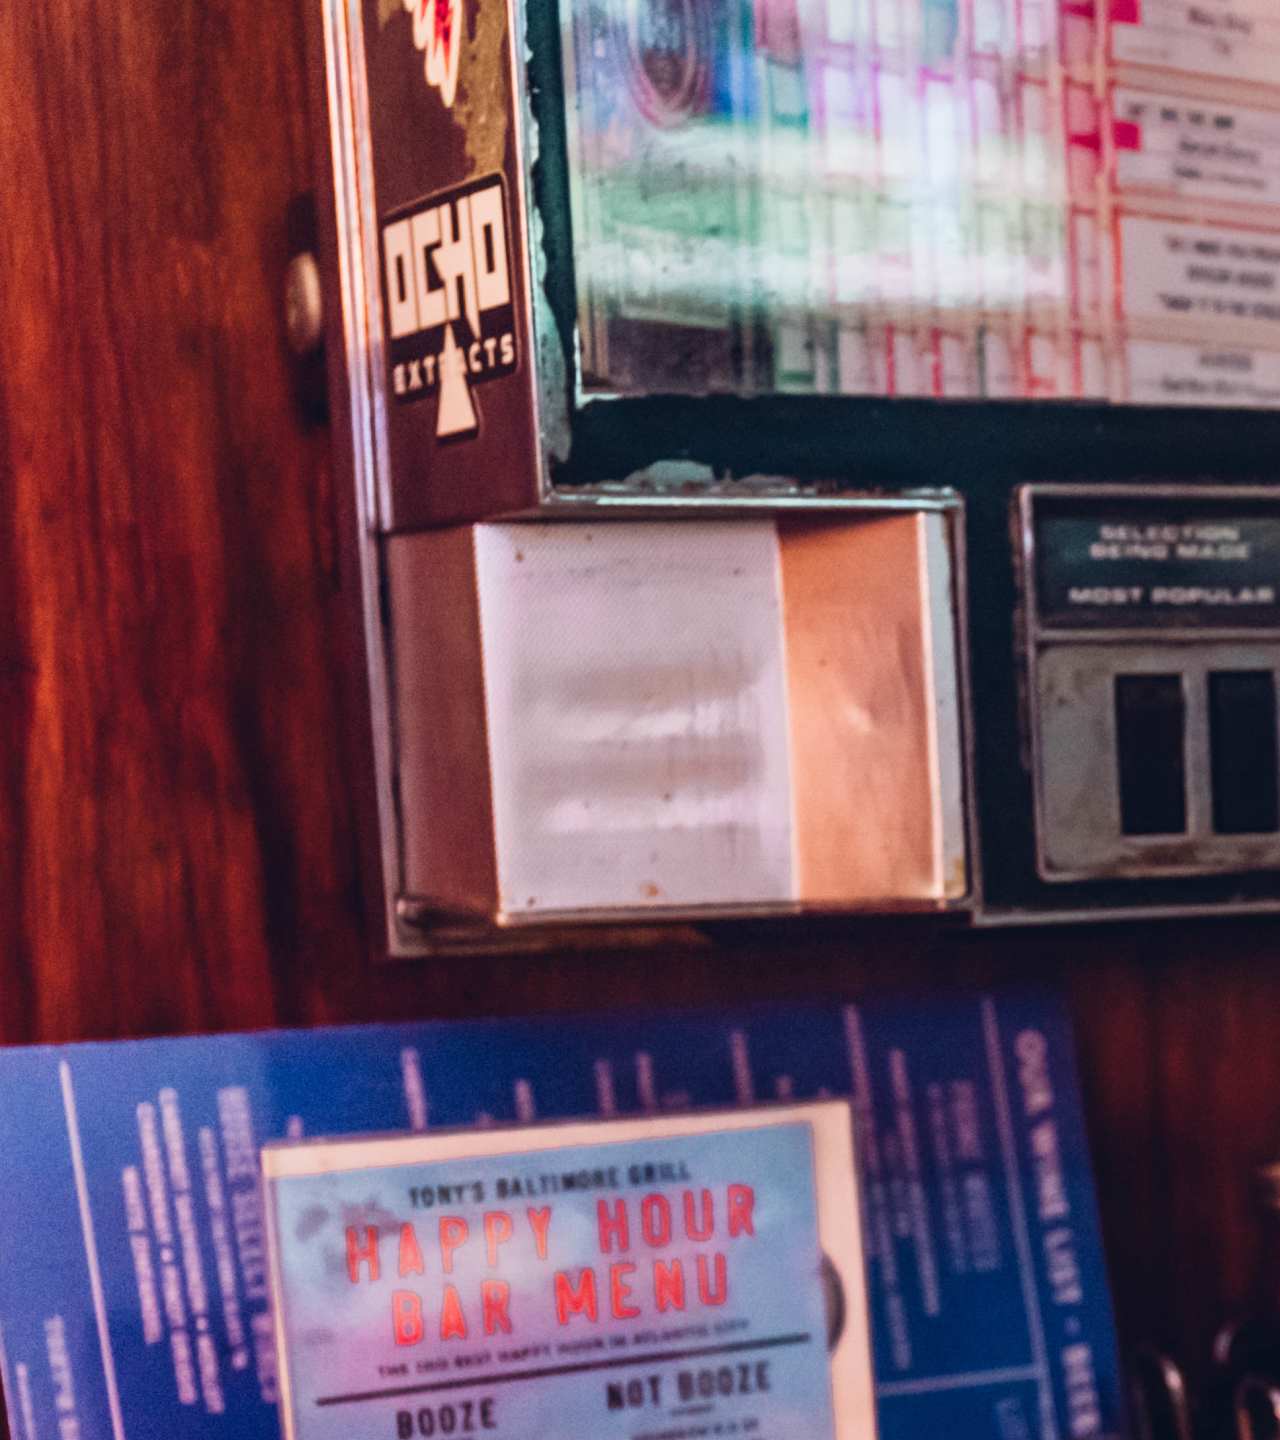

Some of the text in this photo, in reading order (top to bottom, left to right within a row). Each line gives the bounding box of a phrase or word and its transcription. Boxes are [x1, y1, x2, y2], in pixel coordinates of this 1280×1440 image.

[383, 183, 512, 341] OCHO
[394, 333, 514, 395] EXTCTS
[1089, 543, 1251, 560] BEING MADE
[1101, 525, 1240, 542] SELECTION
[1068, 587, 1275, 604] MOST POPULAR
[408, 1159, 692, 1209] TONY'S BALTIMORE GRILL
[345, 1183, 757, 1285] HAPPY HOUR
[391, 1253, 729, 1347] BAR MENU
[605, 1361, 772, 1412] NOT BOOZE
